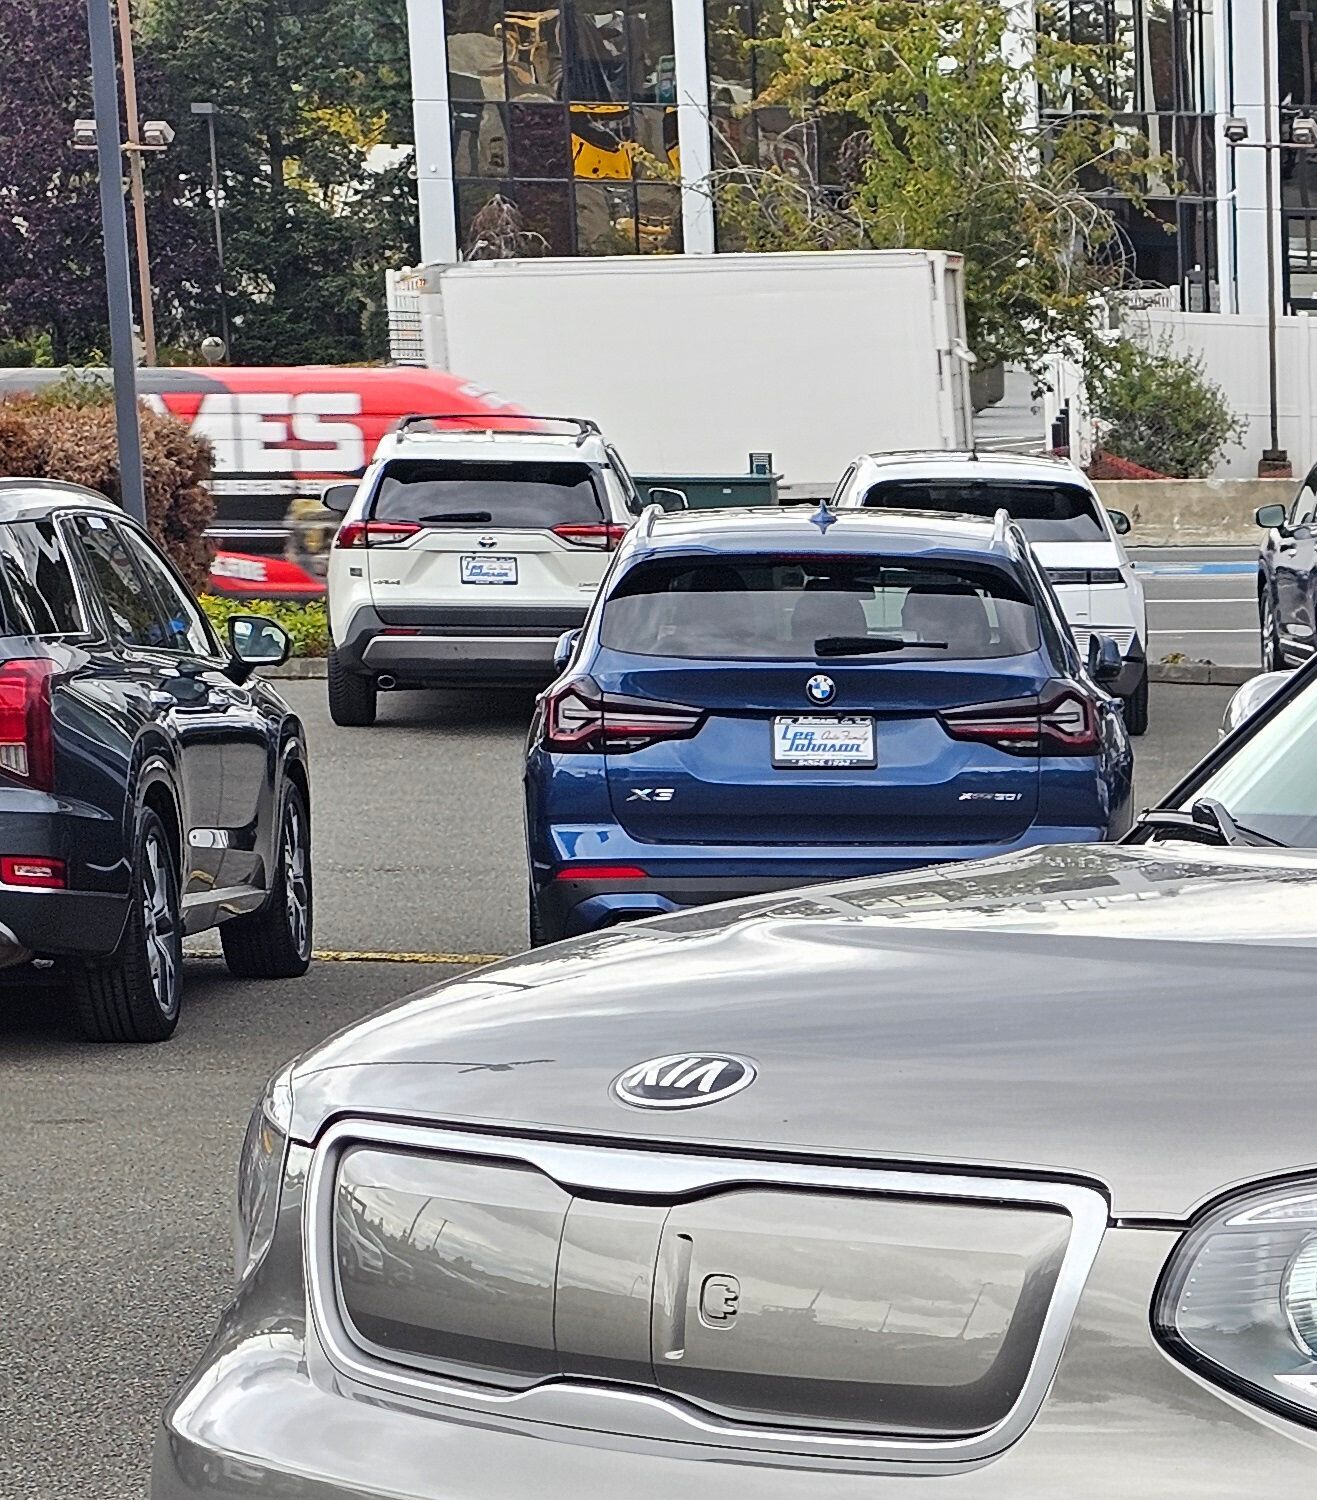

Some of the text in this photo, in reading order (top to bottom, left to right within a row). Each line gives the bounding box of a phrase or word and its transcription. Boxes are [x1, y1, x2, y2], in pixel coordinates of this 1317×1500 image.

[782, 725, 819, 740] Lee
[783, 737, 863, 752] Johnson
[625, 788, 675, 802] X3
[627, 1056, 730, 1093] KIA
